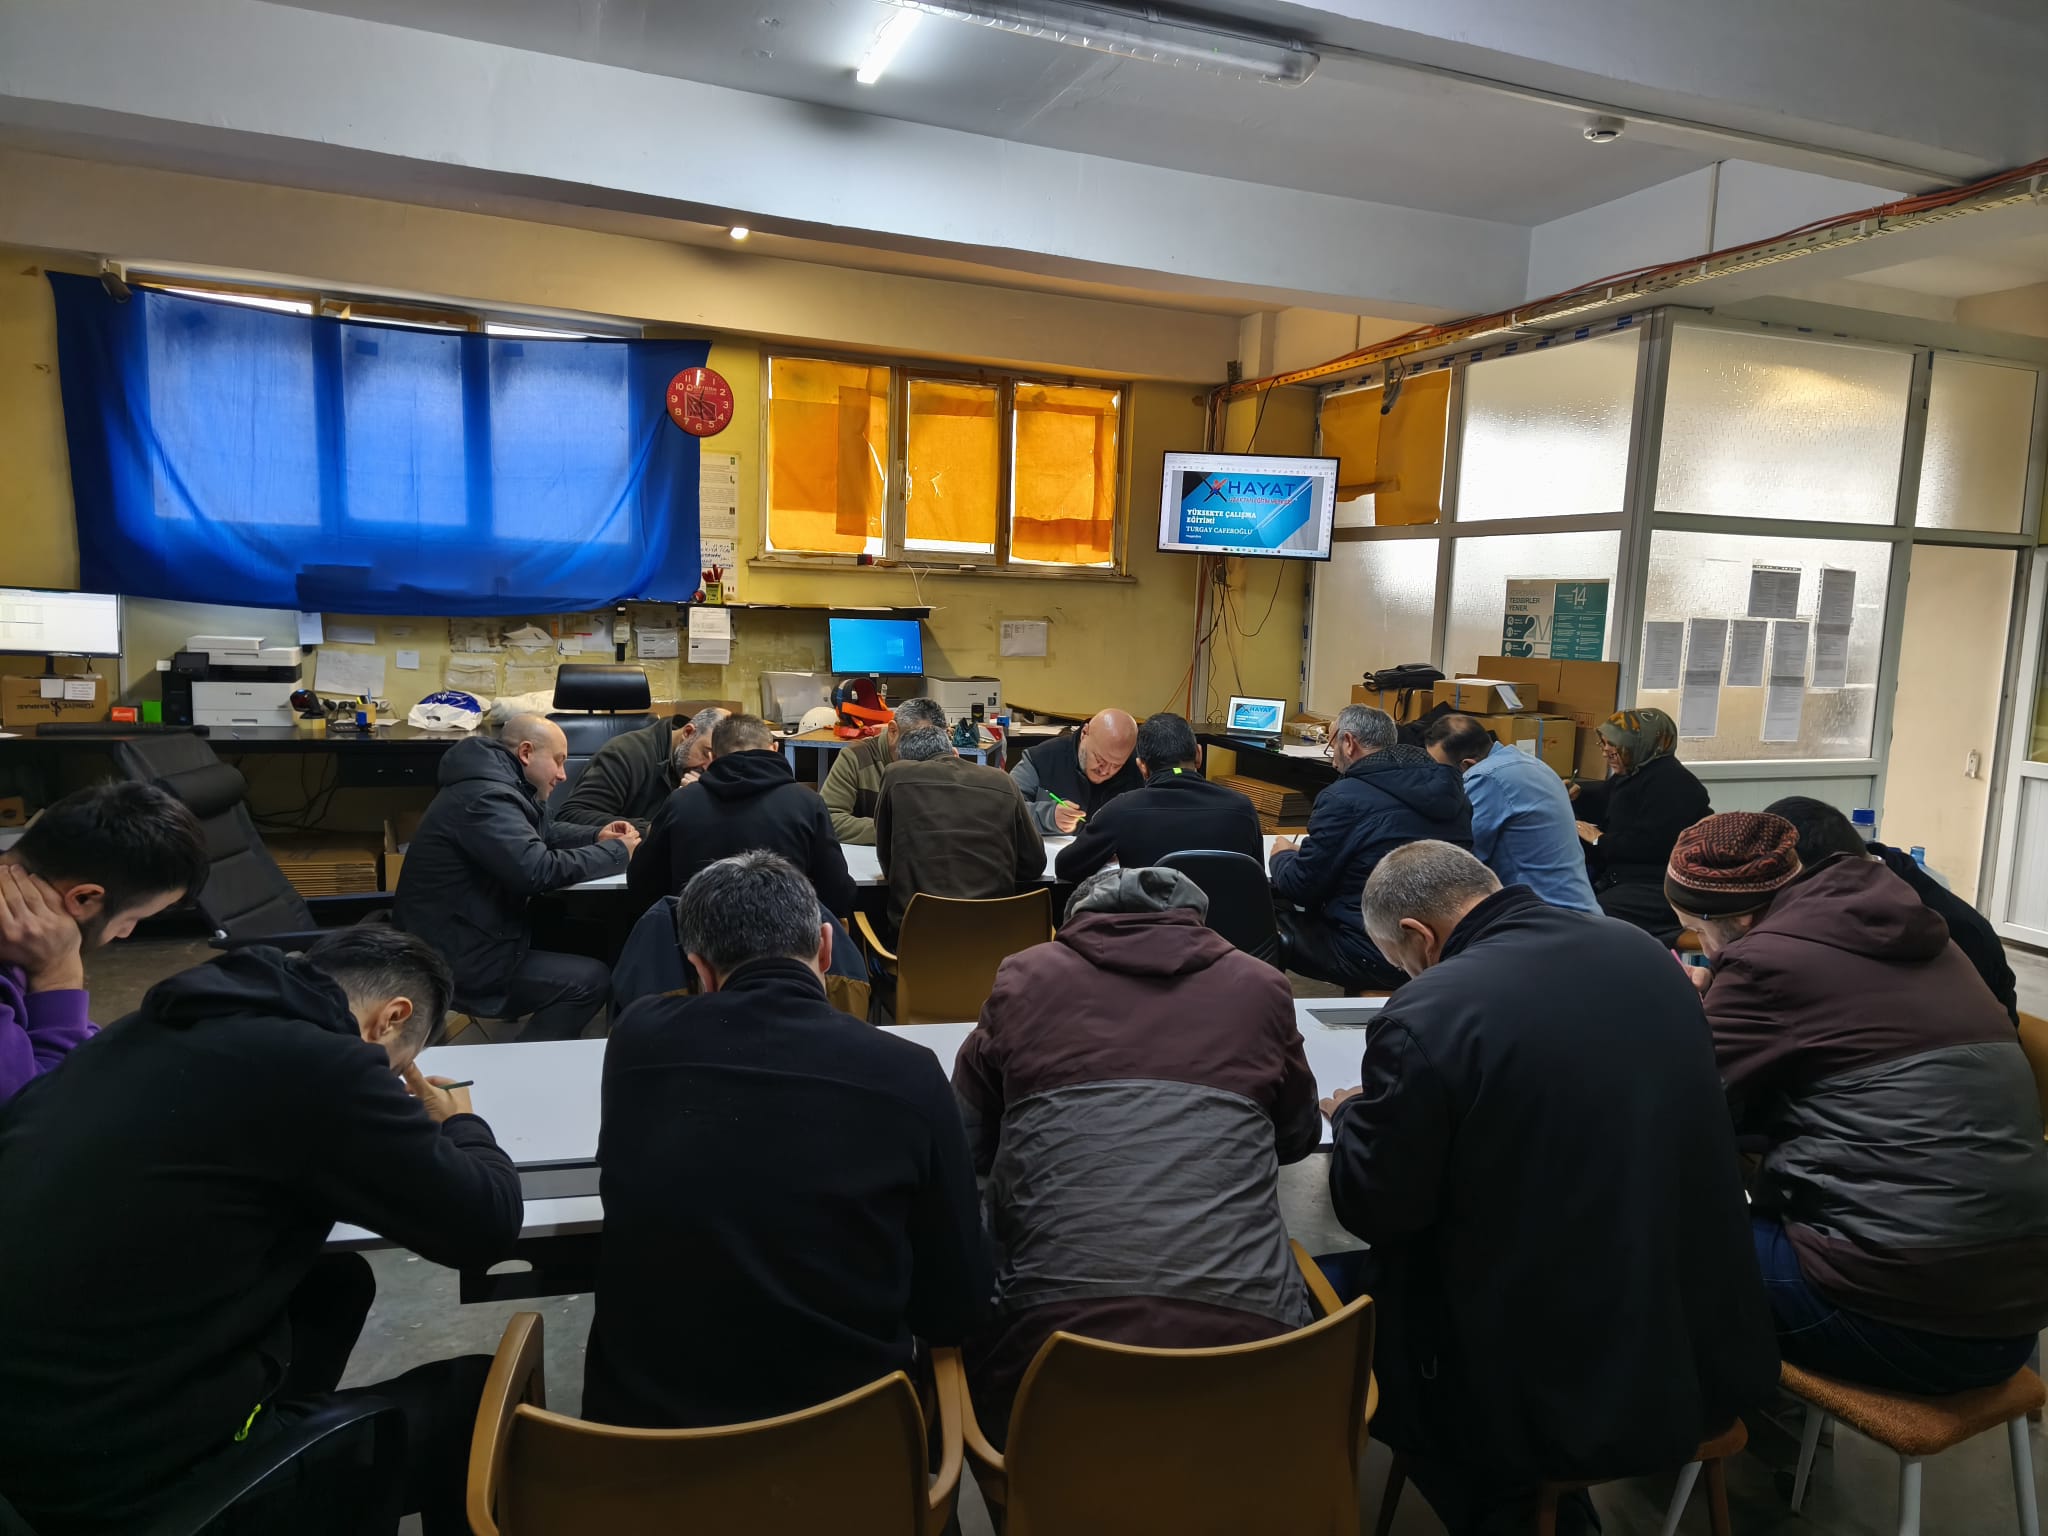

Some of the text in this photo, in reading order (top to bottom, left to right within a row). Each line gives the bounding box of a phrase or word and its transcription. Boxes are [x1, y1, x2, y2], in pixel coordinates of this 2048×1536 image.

[1228, 481, 1296, 497] HAYAT
[1187, 508, 1257, 519] YÜKSEKTE ÇALIŞMA
[1186, 516, 1216, 525] EĞİTİMİ
[1186, 526, 1253, 536] TURGAY CAFEROĞLU
[1572, 587, 1587, 606] 14
